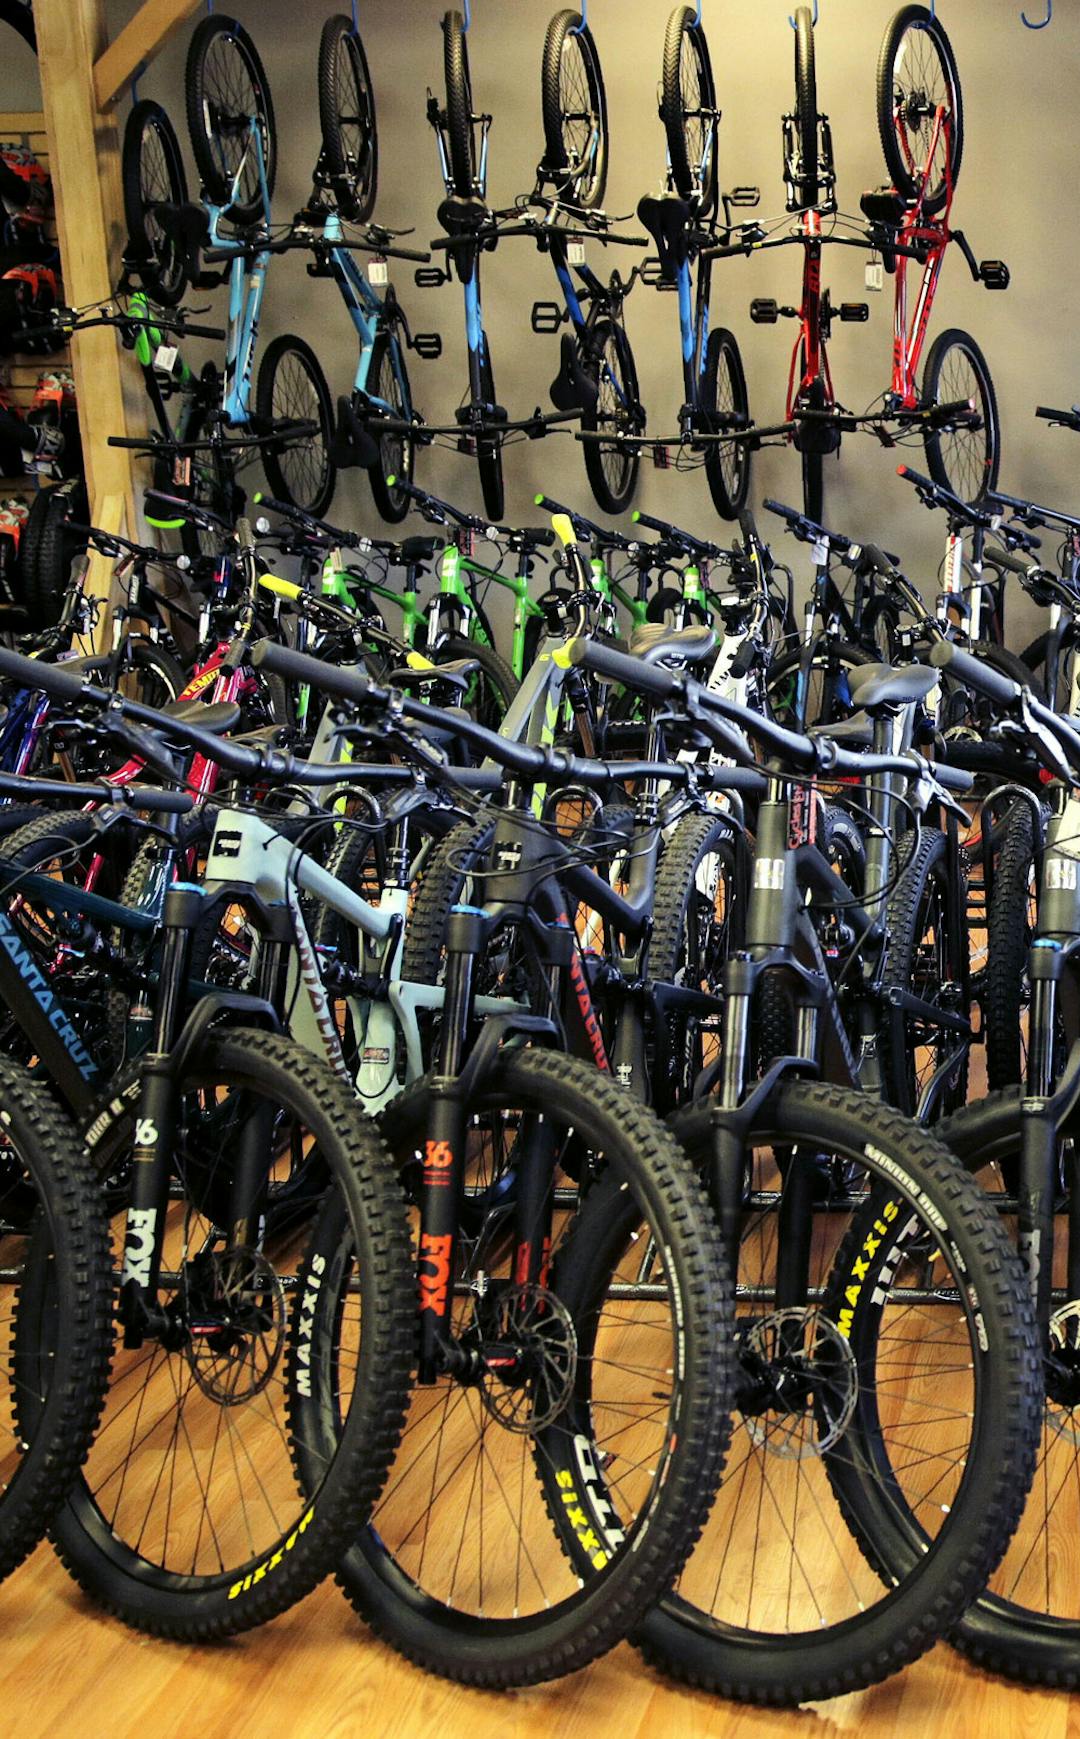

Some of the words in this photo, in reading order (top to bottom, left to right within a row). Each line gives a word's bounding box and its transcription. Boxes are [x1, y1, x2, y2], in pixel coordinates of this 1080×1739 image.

[0, 912, 57, 1014] SANTA
[49, 1008, 100, 1081] CRUZ
[316, 1017, 348, 1076] CRU
[584, 1013, 608, 1070] CRU
[424, 1140, 453, 1168] 36
[865, 1143, 922, 1198] MINION
[122, 1208, 157, 1288] FOX
[418, 1233, 453, 1317] FOX
[837, 1199, 900, 1339] MAXXIS
[296, 1253, 325, 1398] MAXXIS
[227, 1505, 315, 1600] MAXXIS
[555, 1469, 609, 1571] AXXIS
